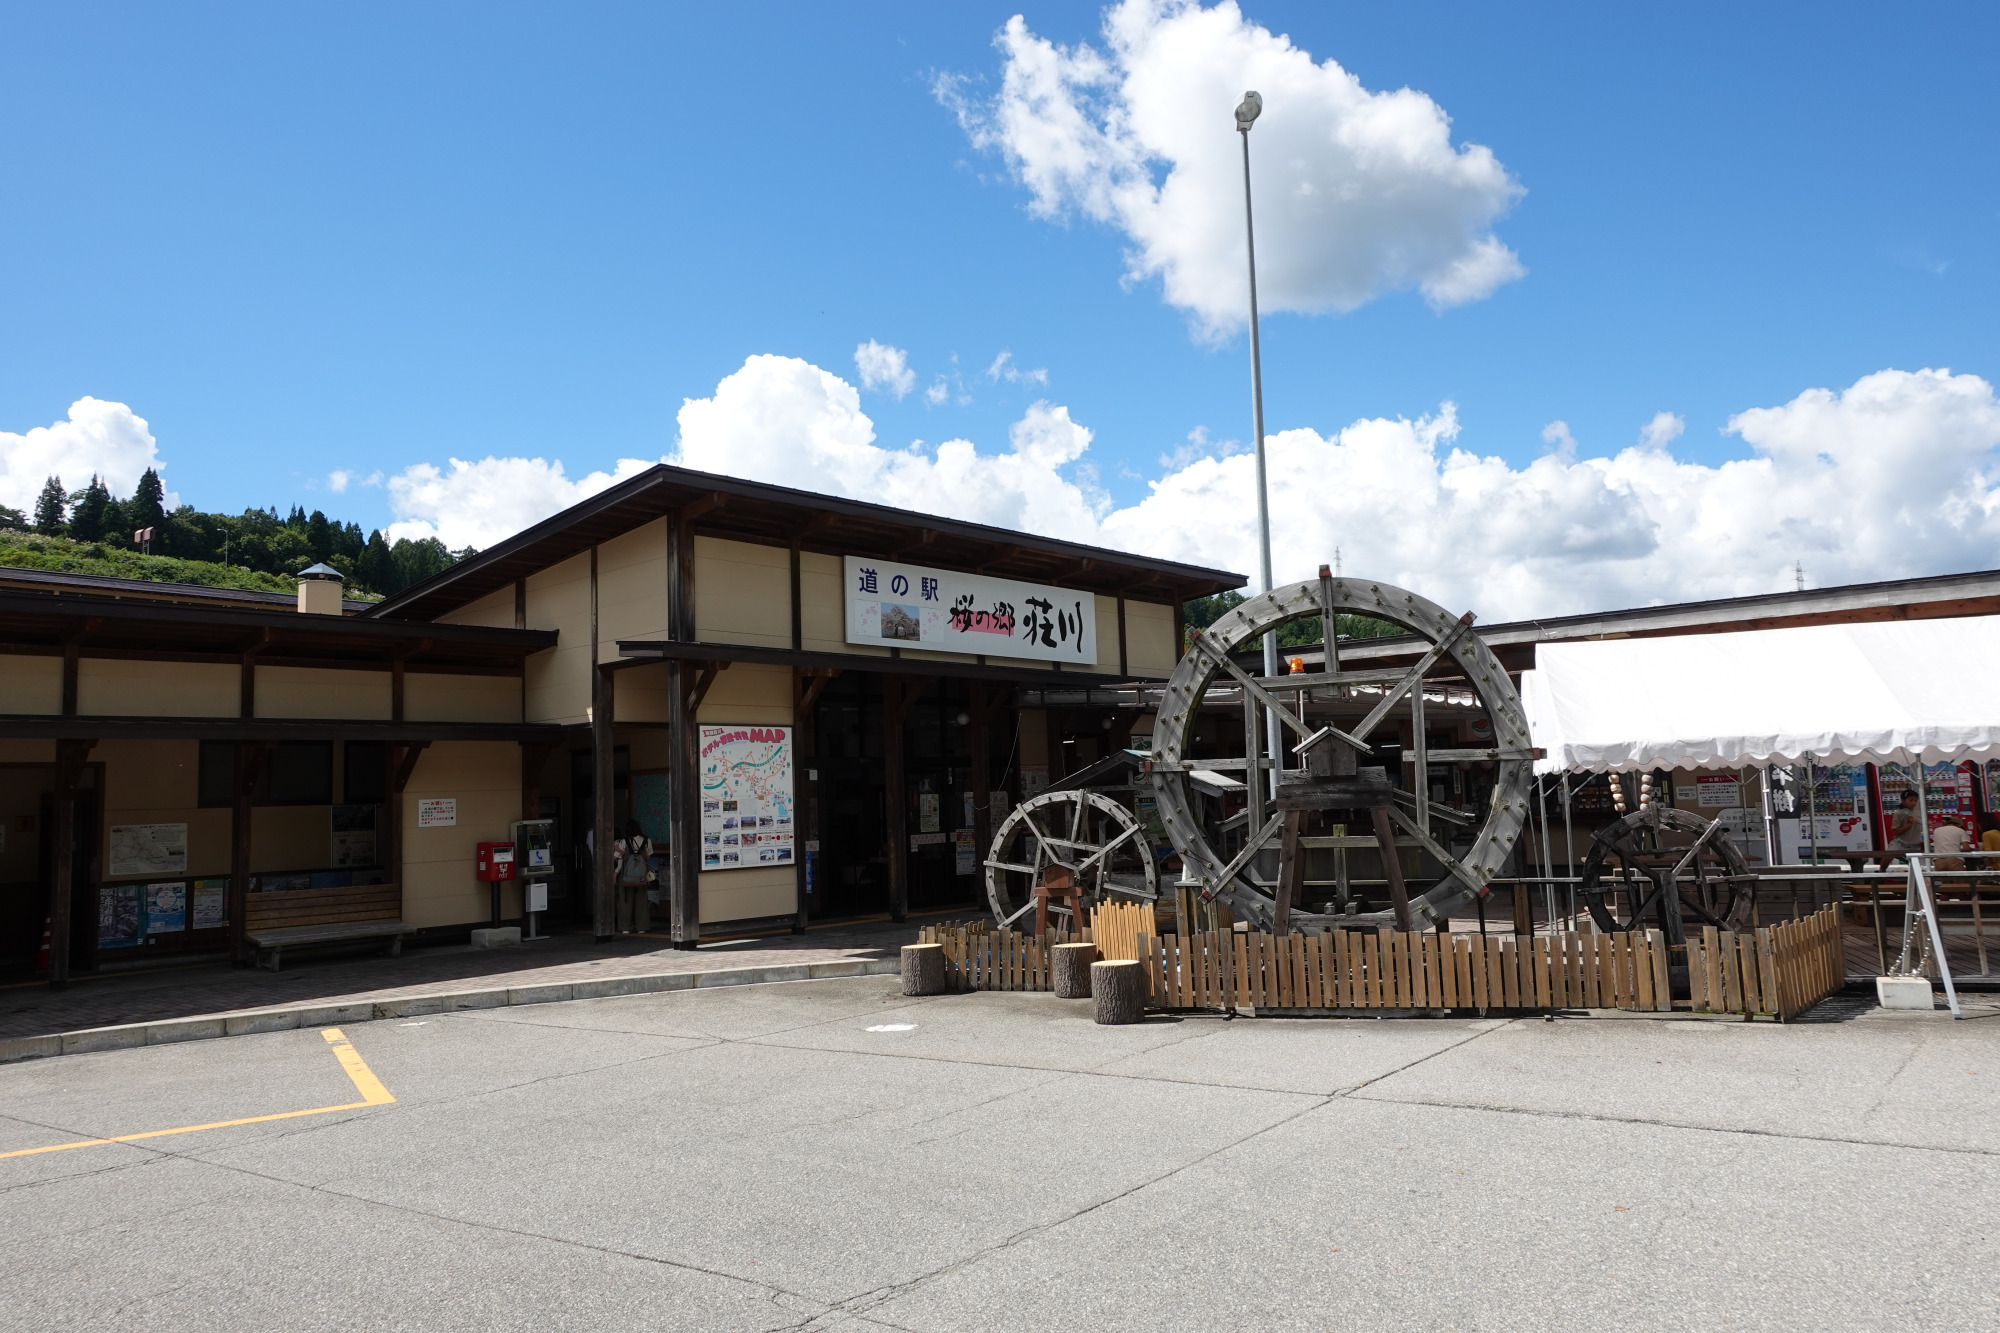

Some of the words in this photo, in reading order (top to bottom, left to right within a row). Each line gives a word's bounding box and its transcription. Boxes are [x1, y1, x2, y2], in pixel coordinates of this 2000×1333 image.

[859, 567, 939, 602] 道の駅
[749, 728, 786, 743] MAP
